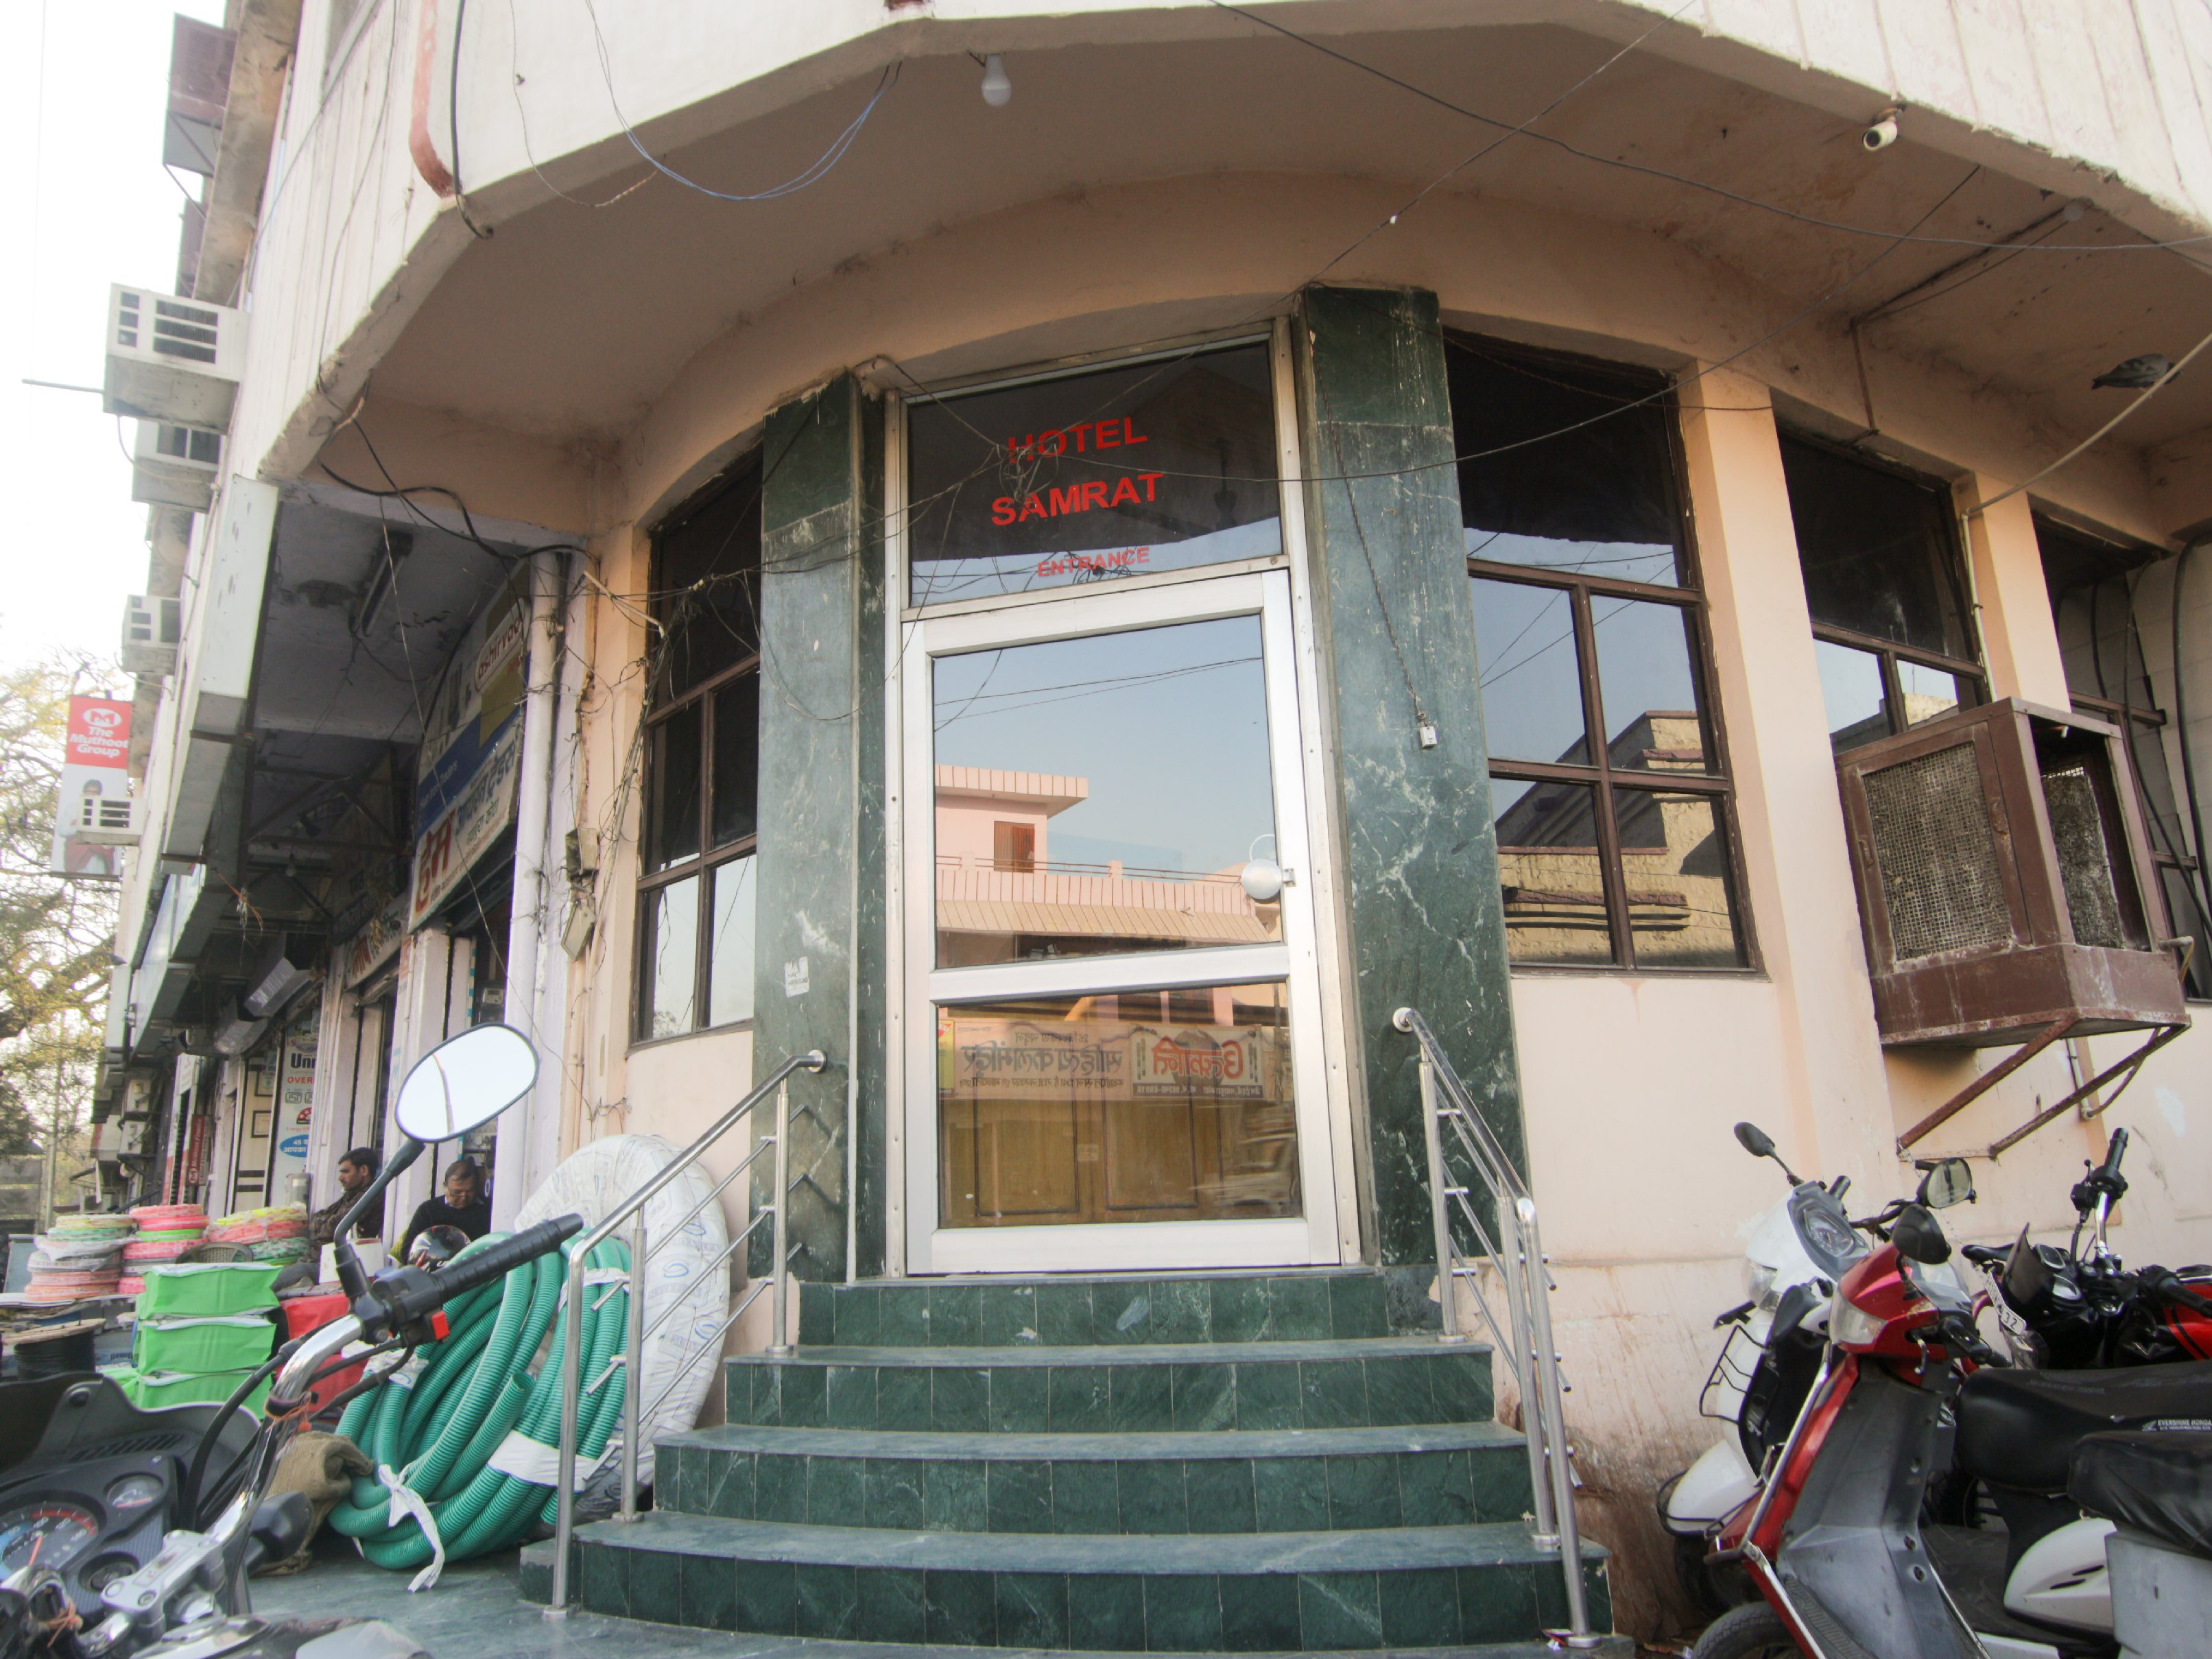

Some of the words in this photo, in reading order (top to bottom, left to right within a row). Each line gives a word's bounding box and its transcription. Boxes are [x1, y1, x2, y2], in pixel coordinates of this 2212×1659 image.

[1008, 416, 1147, 464] HOTEL
[991, 473, 1164, 526] SAMRAT
[1037, 547, 1150, 577] ENTRANCE
[70, 732, 129, 748] Muthoot
[88, 726, 115, 737] The
[76, 743, 120, 759] Group
